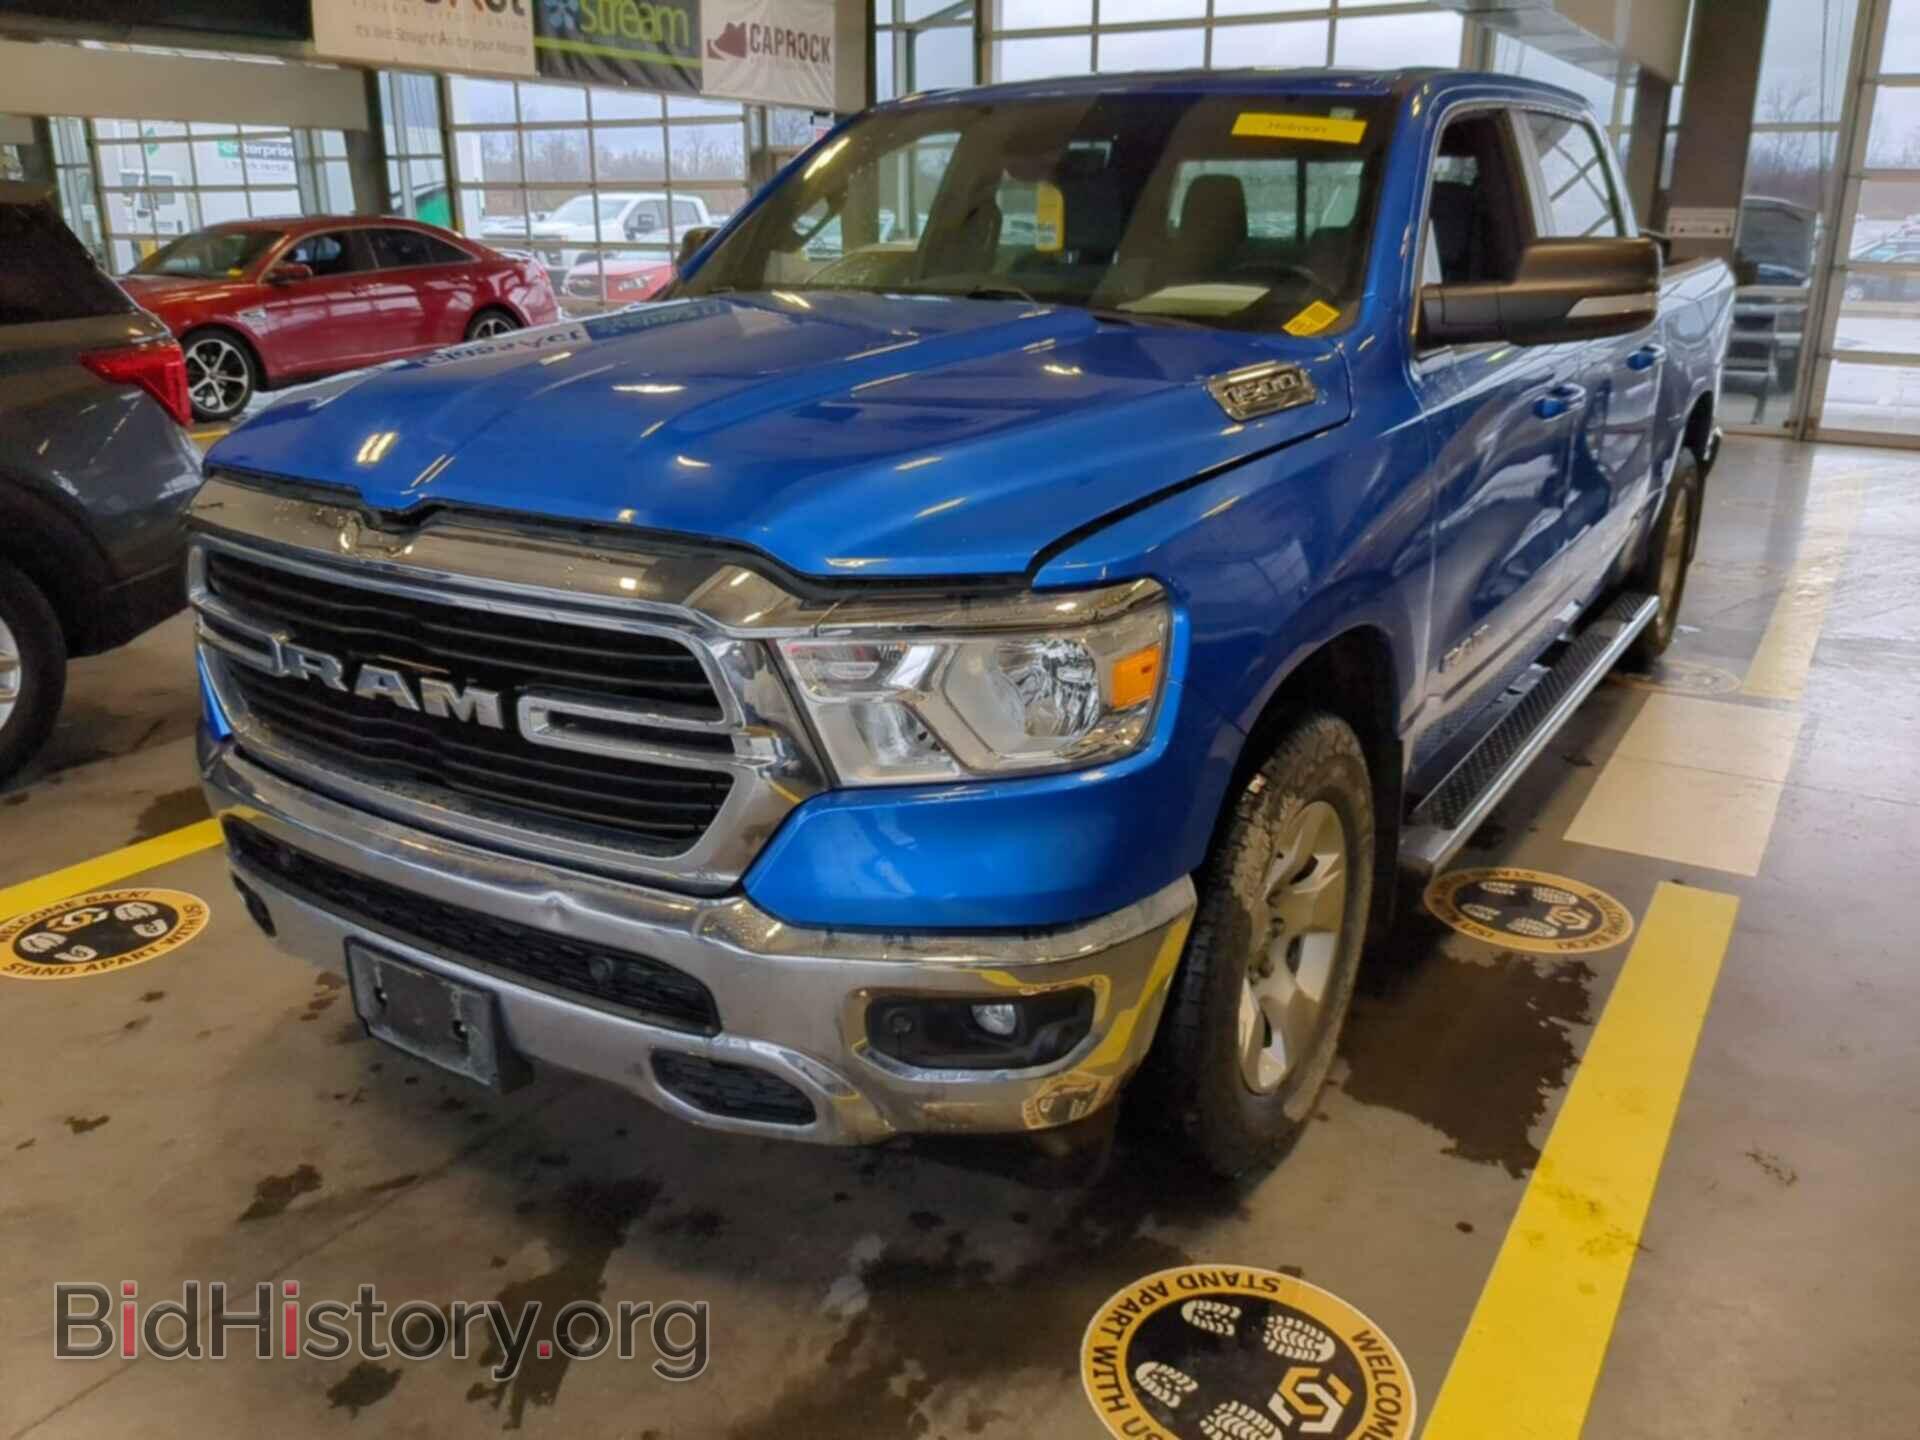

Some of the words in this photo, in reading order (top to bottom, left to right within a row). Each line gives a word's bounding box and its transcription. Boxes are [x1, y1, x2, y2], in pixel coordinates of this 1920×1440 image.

[750, 22, 832, 64] CAPROCK
[287, 643, 503, 730] RAM
[2, 962, 75, 977] STAND
[83, 946, 159, 972] APART
[1176, 1270, 1281, 1293] STAND
[1101, 1280, 1169, 1341] APART
[1092, 1345, 1131, 1413] WITH
